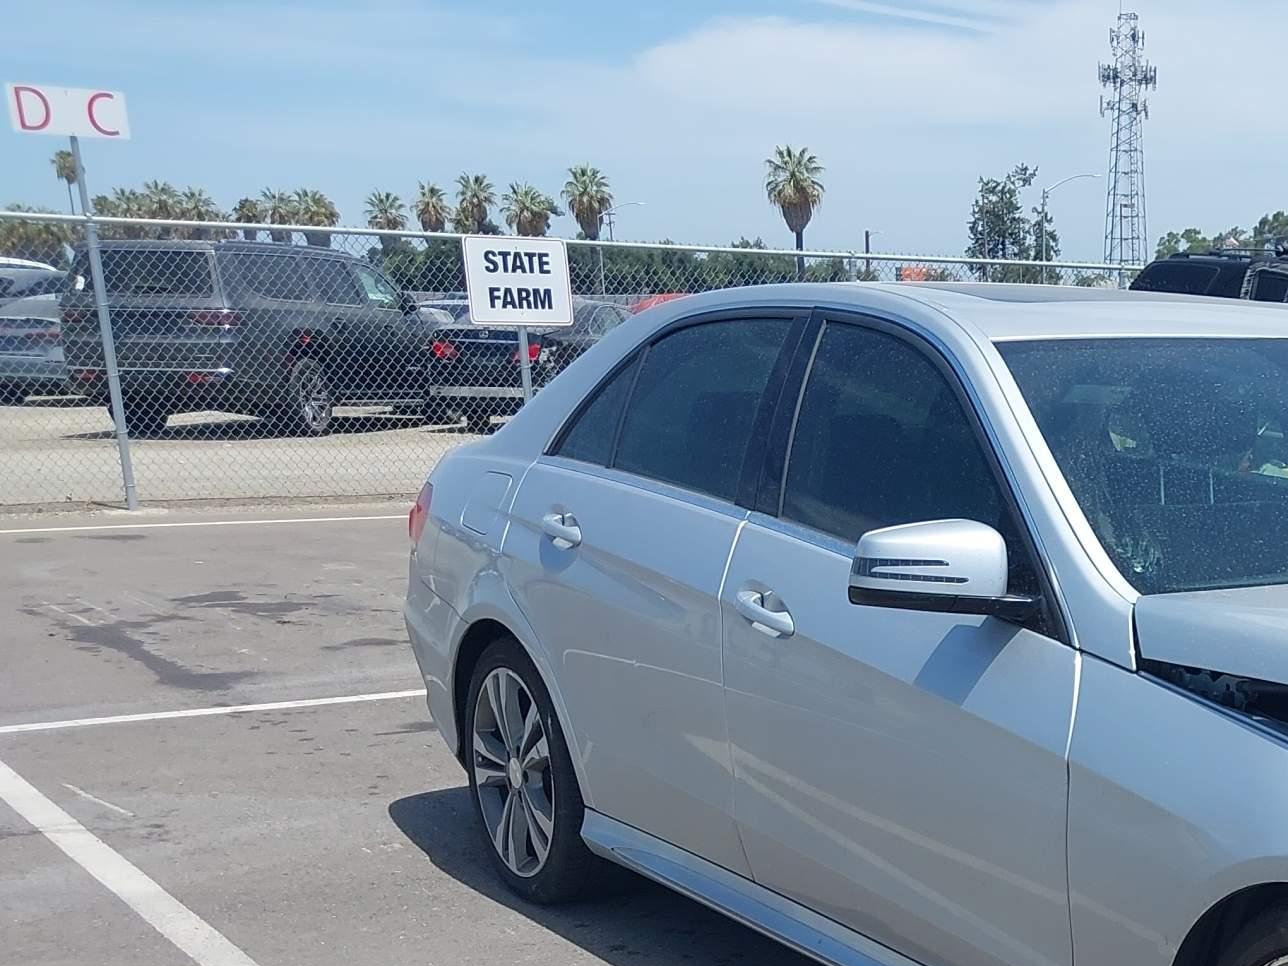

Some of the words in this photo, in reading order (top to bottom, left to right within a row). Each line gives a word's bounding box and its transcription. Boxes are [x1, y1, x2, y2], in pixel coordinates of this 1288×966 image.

[14, 86, 51, 131] D
[88, 92, 120, 136] C
[483, 250, 551, 275] STATE
[488, 287, 553, 310] FARM
